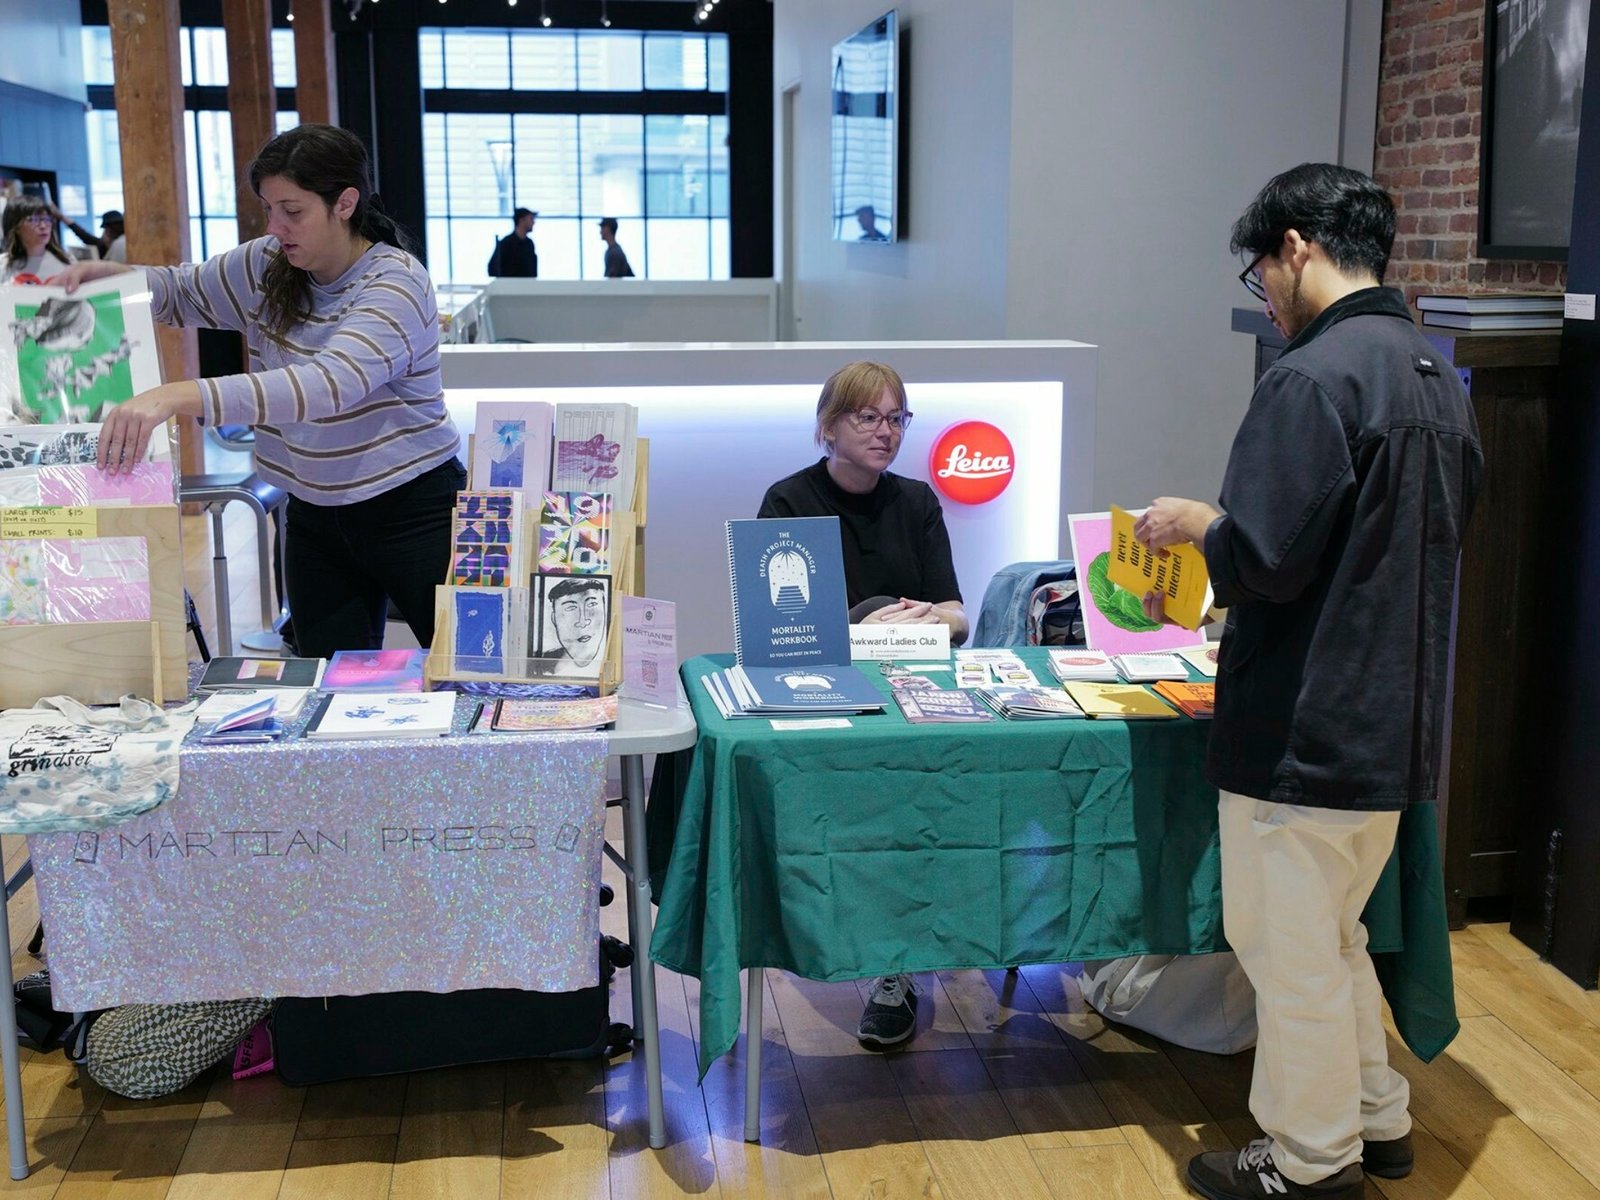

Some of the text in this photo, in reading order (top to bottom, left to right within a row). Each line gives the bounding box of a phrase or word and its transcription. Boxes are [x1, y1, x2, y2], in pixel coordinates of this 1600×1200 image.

[938, 444, 1011, 479] Leica
[760, 540, 817, 577] DEATH PROJECT MANAGER
[1116, 530, 1127, 563] never
[1129, 541, 1140, 567] date
[1142, 548, 1154, 578] dude
[1167, 552, 1182, 599] internet
[771, 625, 815, 635] MORTALITY
[771, 635, 818, 646] WORKBOOK
[850, 637, 938, 646] Awkward Ladies Club
[119, 825, 536, 859] MARTIAN PRESS
[1258, 1172, 1288, 1194] N
